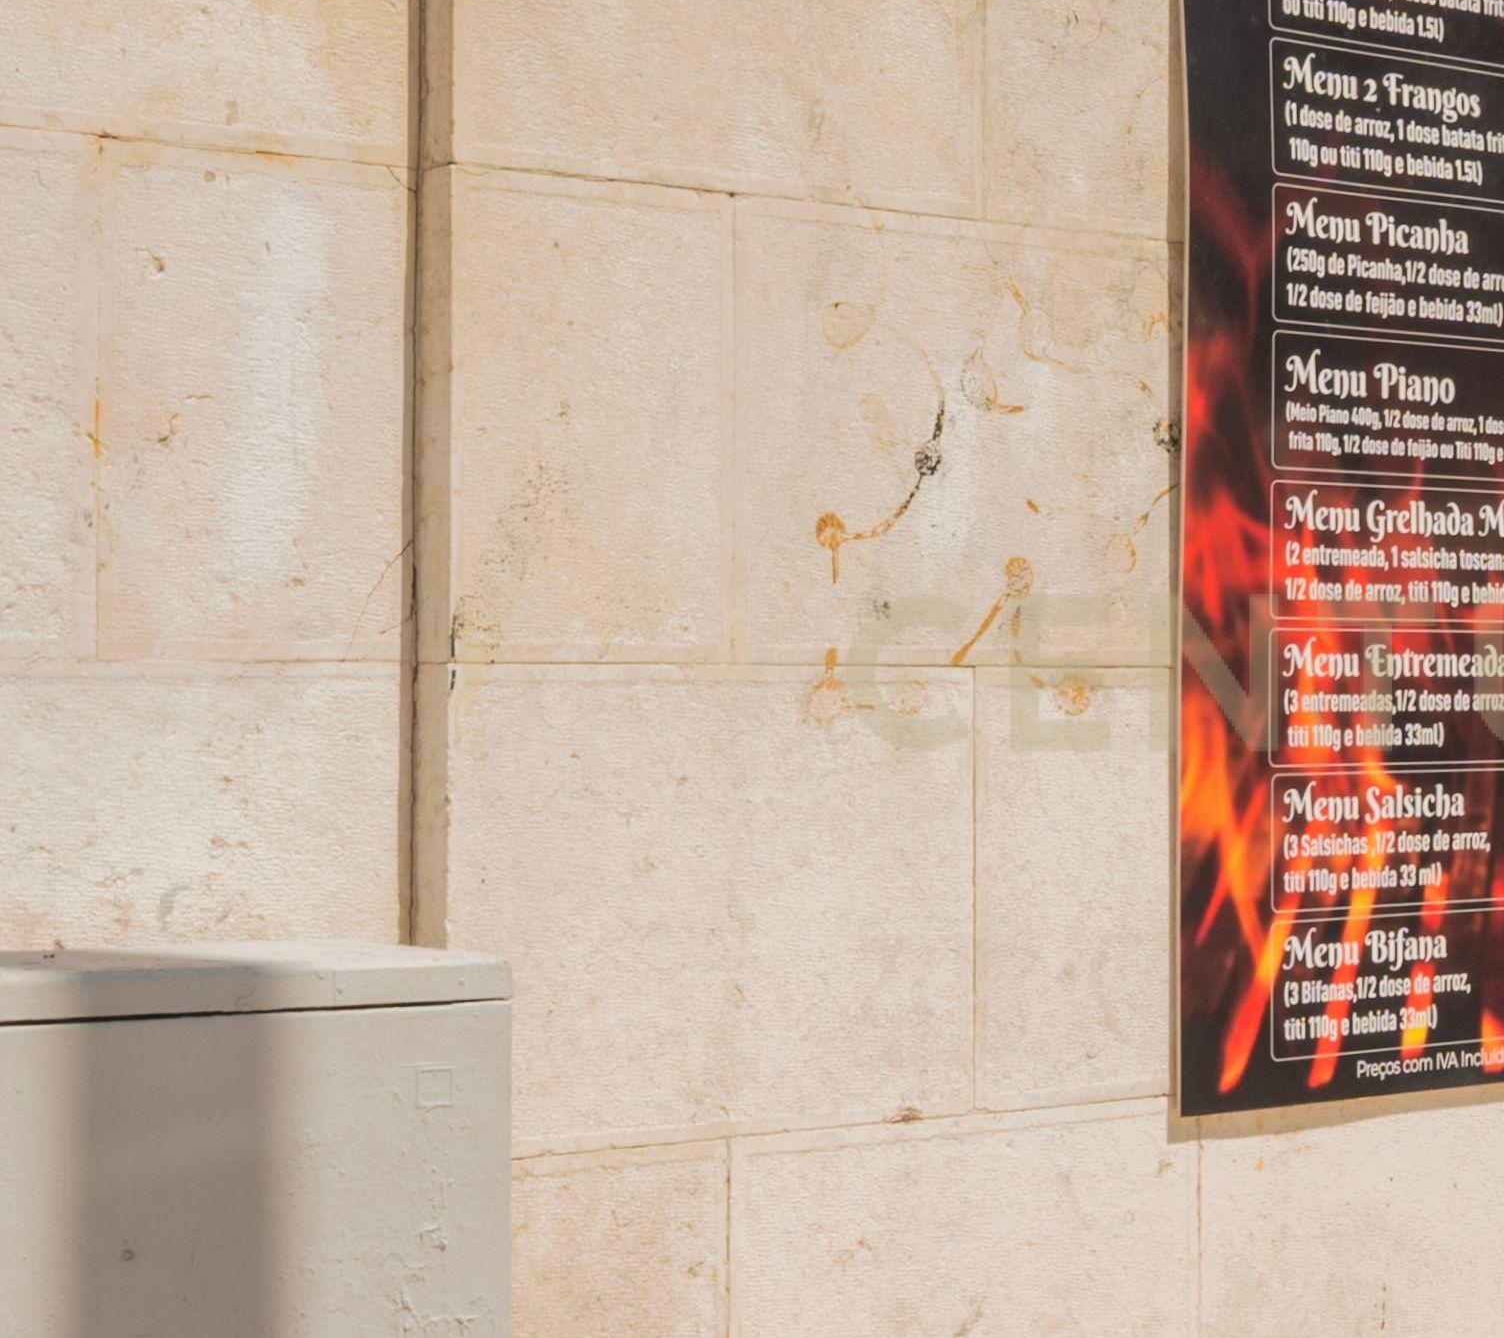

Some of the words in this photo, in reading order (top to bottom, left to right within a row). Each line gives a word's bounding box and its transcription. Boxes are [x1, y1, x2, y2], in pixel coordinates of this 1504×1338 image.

[1327, 0, 1355, 30] 110g
[1358, 9, 1366, 27] e
[1370, 7, 1415, 33] bebida
[1283, 53, 1358, 101] Menu
[1364, 79, 1377, 103] 2
[1383, 73, 1482, 123] Frangos
[1285, 198, 1360, 245] Menu
[1365, 211, 1469, 255] Picanha
[1287, 247, 1325, 278] (250g
[1328, 252, 1345, 276] de
[1428, 263, 1460, 288] dose
[1464, 267, 1479, 290] de
[1286, 283, 1307, 307] 1/2
[1310, 285, 1342, 311] dose
[1346, 290, 1362, 312] de
[1366, 291, 1404, 319] feijão
[1408, 299, 1416, 317] e
[1419, 296, 1464, 323] bebida
[1466, 301, 1503, 327] 33ml)
[1284, 349, 1367, 399] Menu
[1374, 363, 1456, 406] Piano
[1284, 489, 1360, 535] Menu
[1366, 500, 1474, 542] Grelhada
[1286, 541, 1300, 569] (2
[1303, 543, 1388, 571] entremeada,
[1392, 546, 1398, 565] 1
[1401, 547, 1457, 571] salsicha
[1286, 577, 1306, 600] 1/2
[1309, 577, 1342, 601] dose
[1346, 579, 1362, 601] de
[1365, 583, 1405, 605] arroz,
[1408, 580, 1428, 603] titi
[1432, 581, 1459, 608] 110g
[1462, 587, 1470, 604] e
[1282, 637, 1360, 681] Menu
[1284, 689, 1298, 715] (3
[1419, 690, 1451, 712] dose
[1454, 690, 1470, 712] de
[1288, 726, 1309, 747] titi
[1312, 725, 1341, 752] 110g
[1344, 729, 1353, 747] e
[1356, 723, 1402, 747] bebida
[1405, 721, 1444, 747] 33ml)
[1282, 781, 1359, 823] Menu
[1365, 783, 1464, 824] Salsicha
[1282, 927, 1359, 971] Menu
[1365, 927, 1447, 971] Bifana
[1284, 981, 1299, 1008] (3
[1379, 975, 1410, 997] dose
[1414, 973, 1430, 994] de
[1433, 971, 1471, 994] arroz,
[1284, 1018, 1305, 1041] titi
[1308, 1016, 1338, 1041] 110g
[1341, 1020, 1350, 1036] e
[1352, 1010, 1396, 1034] bebida
[1399, 1004, 1437, 1030] 33ml)
[1356, 1059, 1400, 1080] Preços
[1403, 1057, 1433, 1073] com
[1436, 1052, 1459, 1069] IVA
